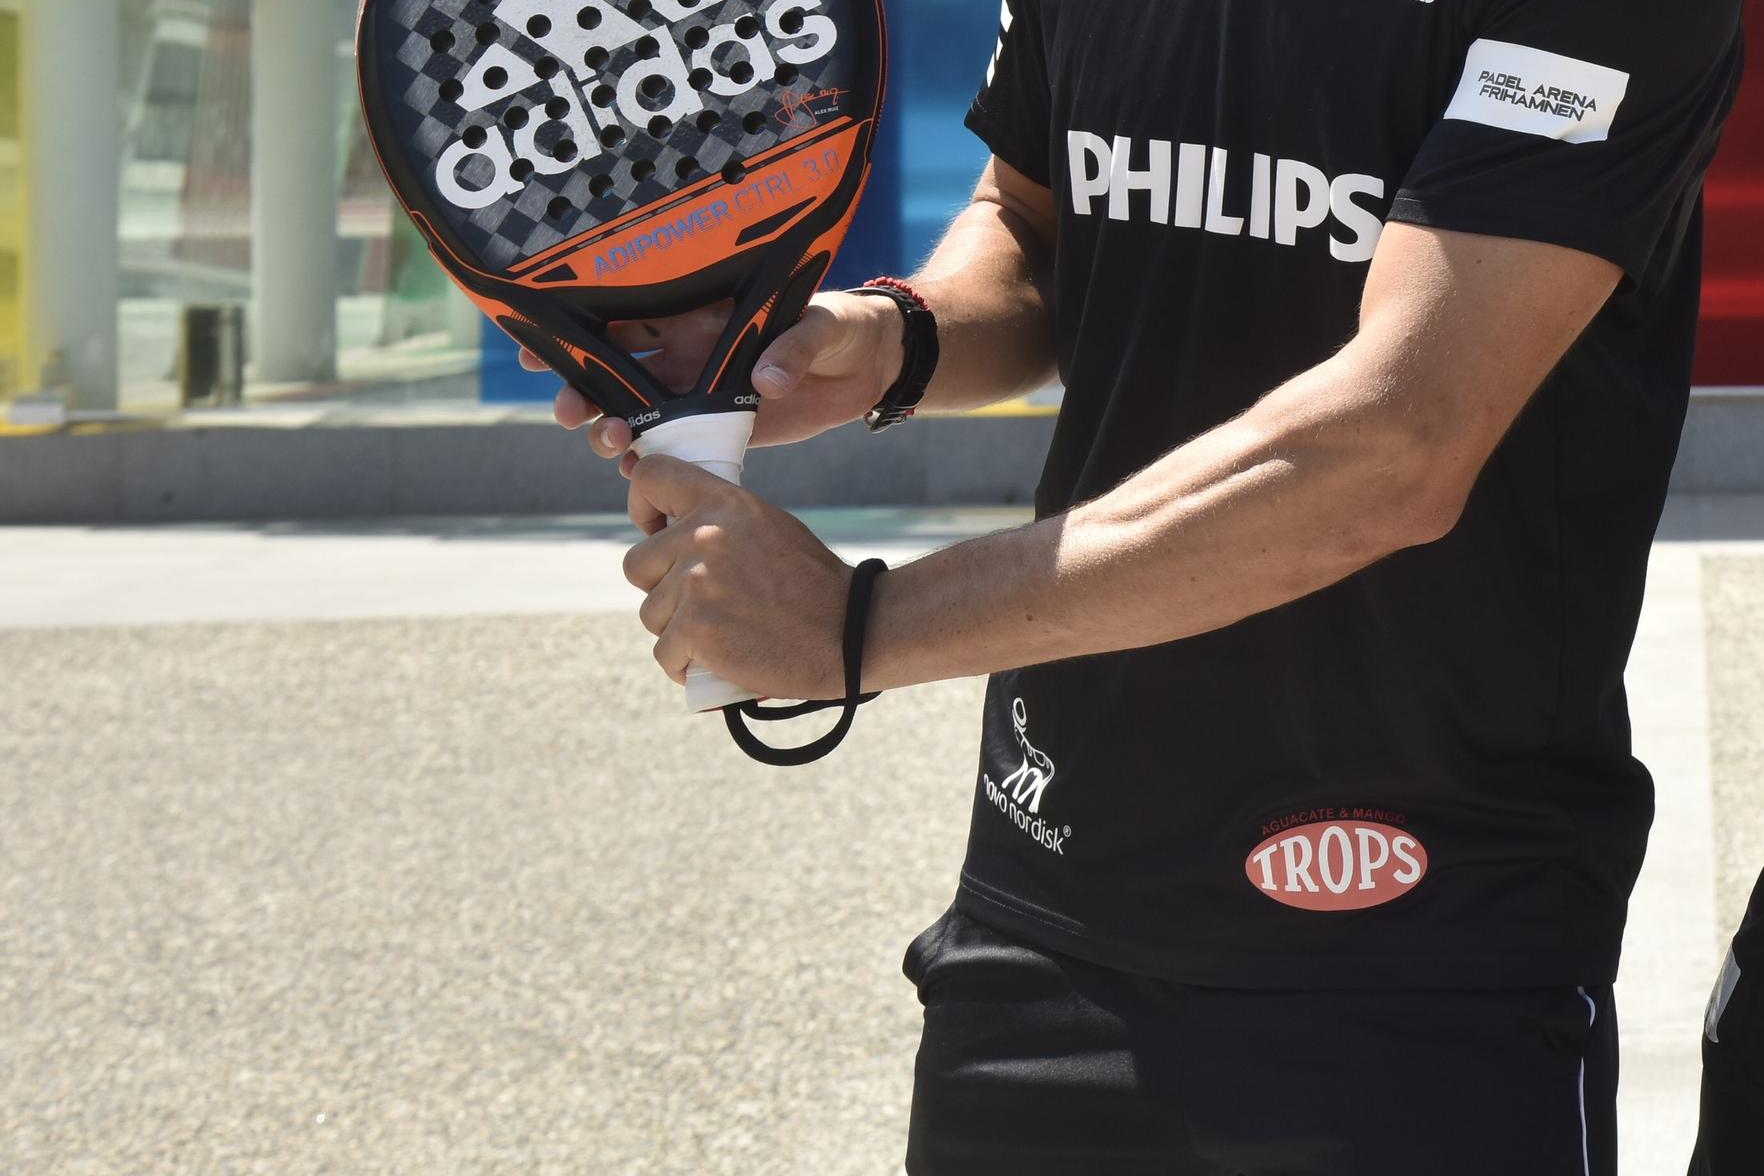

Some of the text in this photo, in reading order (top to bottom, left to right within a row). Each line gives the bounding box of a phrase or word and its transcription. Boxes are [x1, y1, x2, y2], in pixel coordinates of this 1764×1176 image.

[1478, 70, 1597, 112] PADEL ARENA
[1479, 84, 1585, 122] FRIHAMNEN
[1067, 129, 1385, 263] PHILIPS
[593, 198, 733, 280] ADIPOWER
[983, 773, 1007, 813] novo
[1260, 808, 1408, 837] AGUACATE & MANGO
[1252, 825, 1422, 894] TROPS
